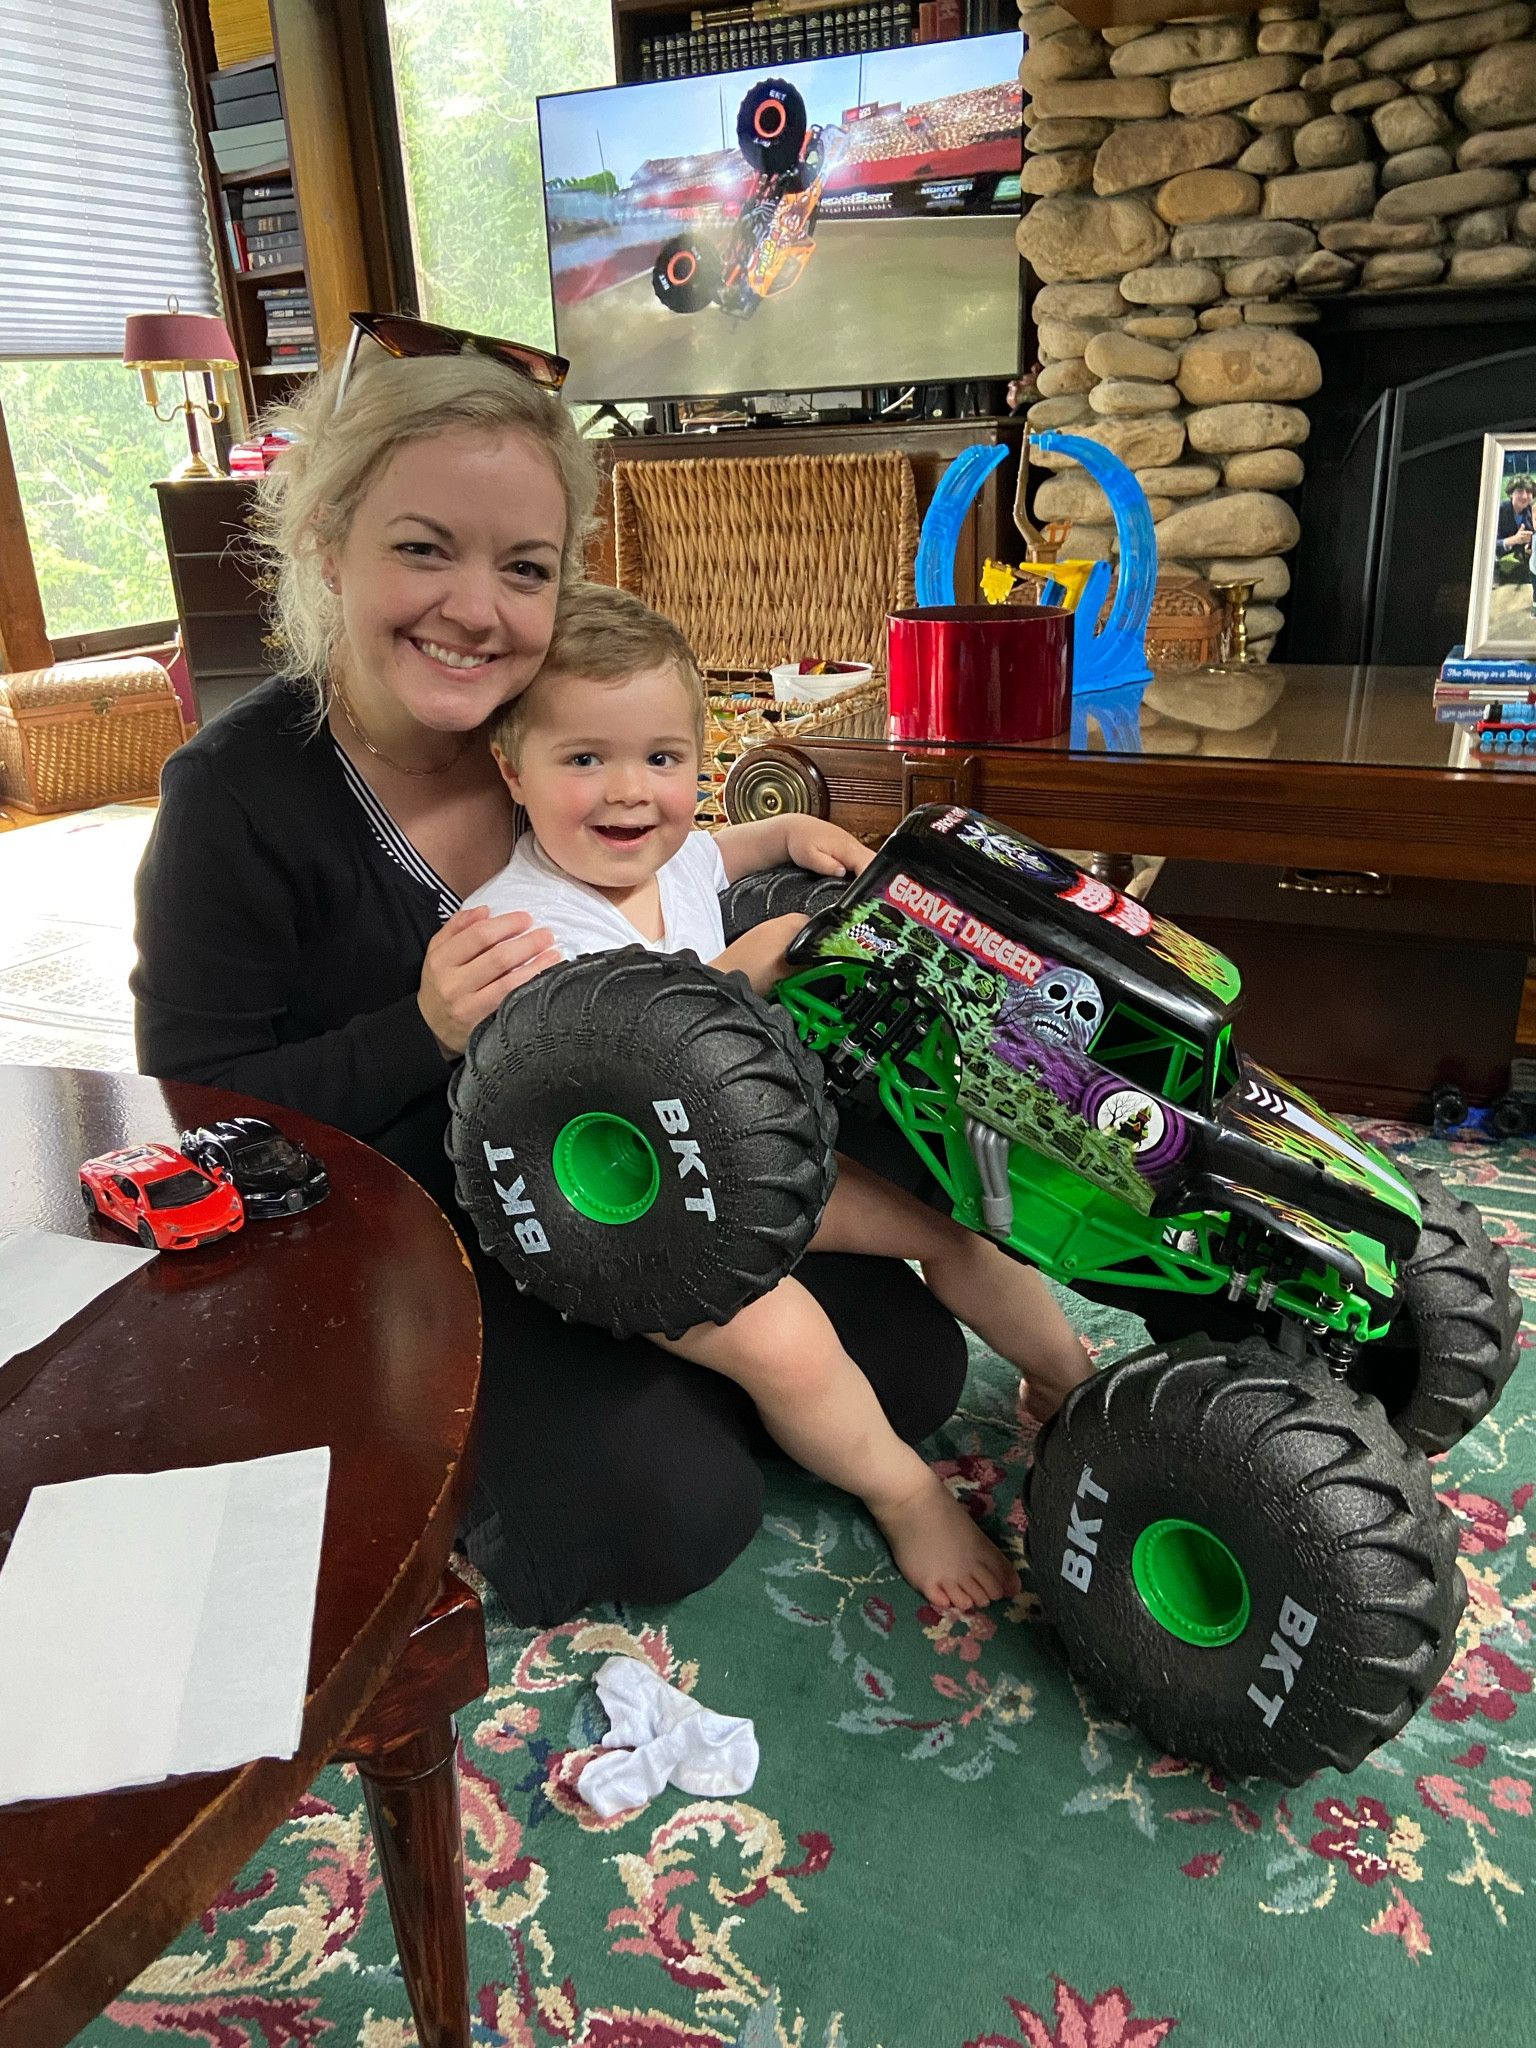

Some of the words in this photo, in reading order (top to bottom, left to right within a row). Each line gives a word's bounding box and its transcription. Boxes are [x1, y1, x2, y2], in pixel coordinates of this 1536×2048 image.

[920, 183, 973, 195] MONSTER
[932, 191, 958, 199] JAM
[1446, 668, 1462, 678] The
[1463, 668, 1489, 680] Happy
[1490, 670, 1498, 678] in
[1507, 669, 1532, 681] Hurry
[888, 873, 963, 934] GRAVE
[959, 917, 1042, 981] DIGGER
[482, 1140, 551, 1255] BKT
[652, 1098, 718, 1222] BKT
[1061, 1467, 1109, 1593] BKT
[1246, 1594, 1318, 1729] BKT
